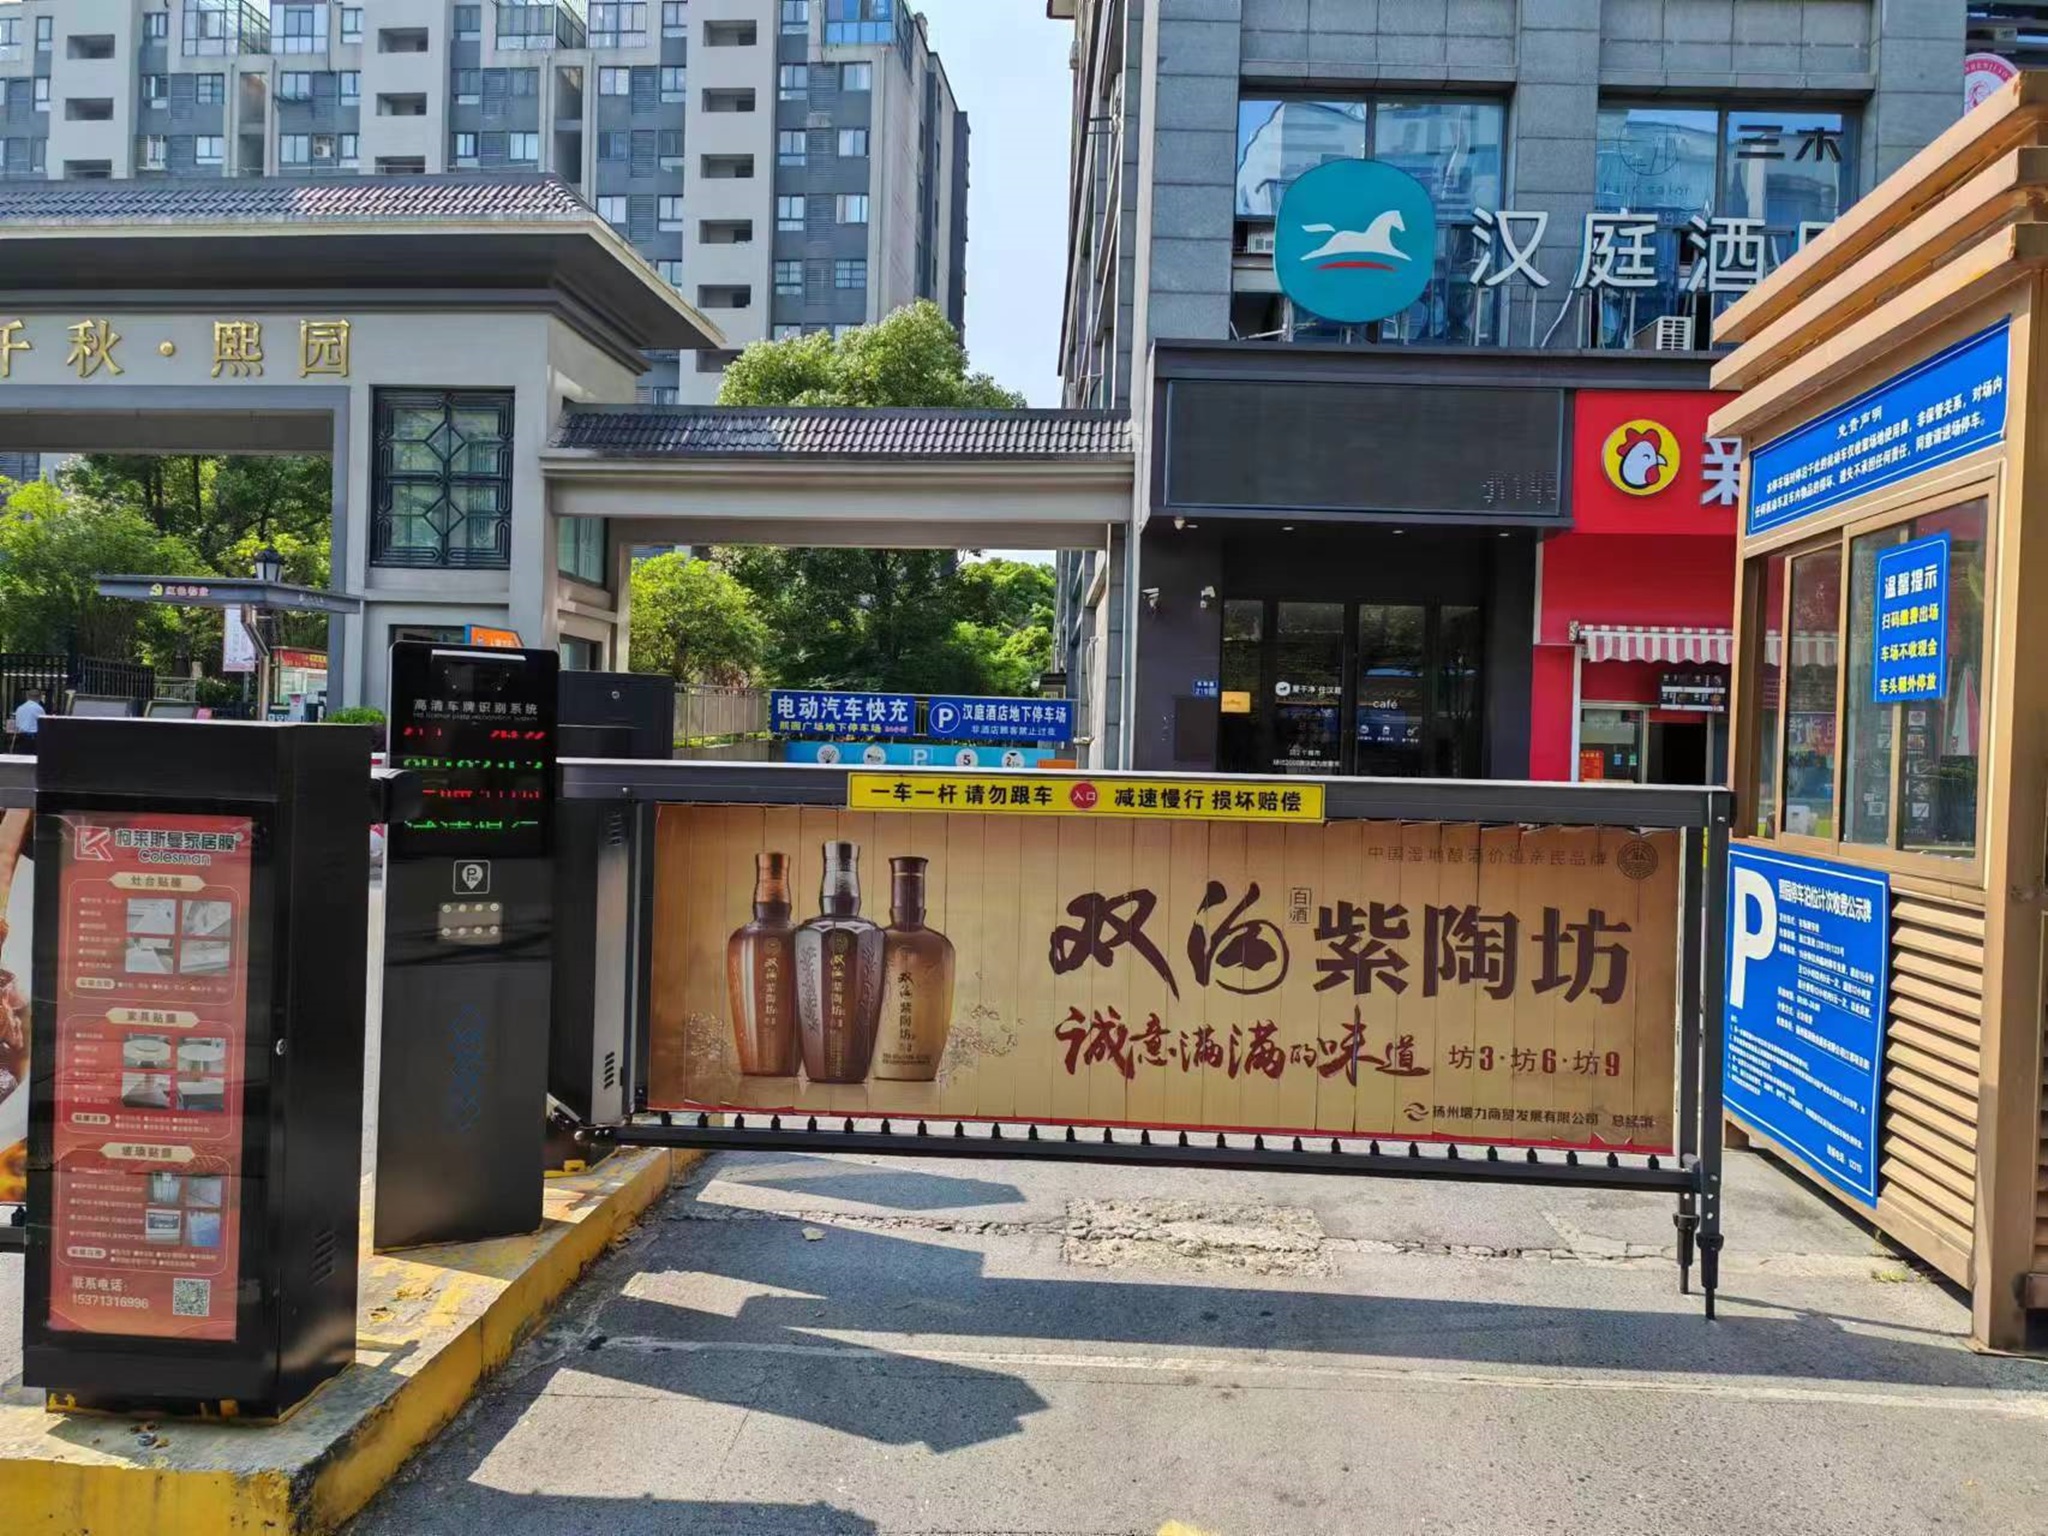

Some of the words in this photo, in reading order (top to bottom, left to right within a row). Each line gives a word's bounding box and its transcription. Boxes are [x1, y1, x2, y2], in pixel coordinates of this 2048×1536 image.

[1737, 125, 1843, 162] 三木
[1470, 206, 1838, 293] 汉庭酒
[1836, 405, 1883, 439] 免责声明
[1884, 563, 1938, 599] 温馨提示
[1882, 603, 1939, 630] 扫码缴费出场
[1881, 638, 1938, 662] 车场不收现金
[413, 699, 538, 715] 高清车牌识别系统
[777, 695, 908, 722] 电动汽车快充
[962, 703, 1067, 724] 汉庭酒店地下停车场
[1372, 699, 1398, 709] café
[870, 783, 958, 803] 一车一杆
[965, 784, 1053, 805] 请勿跟车
[1073, 791, 1097, 802] 入口
[1114, 787, 1204, 810] 减速慢行
[1211, 789, 1302, 812] 损坏赔偿
[115, 828, 236, 853] 柯莱斯曼家居膜
[138, 850, 211, 866] Colesman
[1313, 900, 1630, 1004] 紫陶坊
